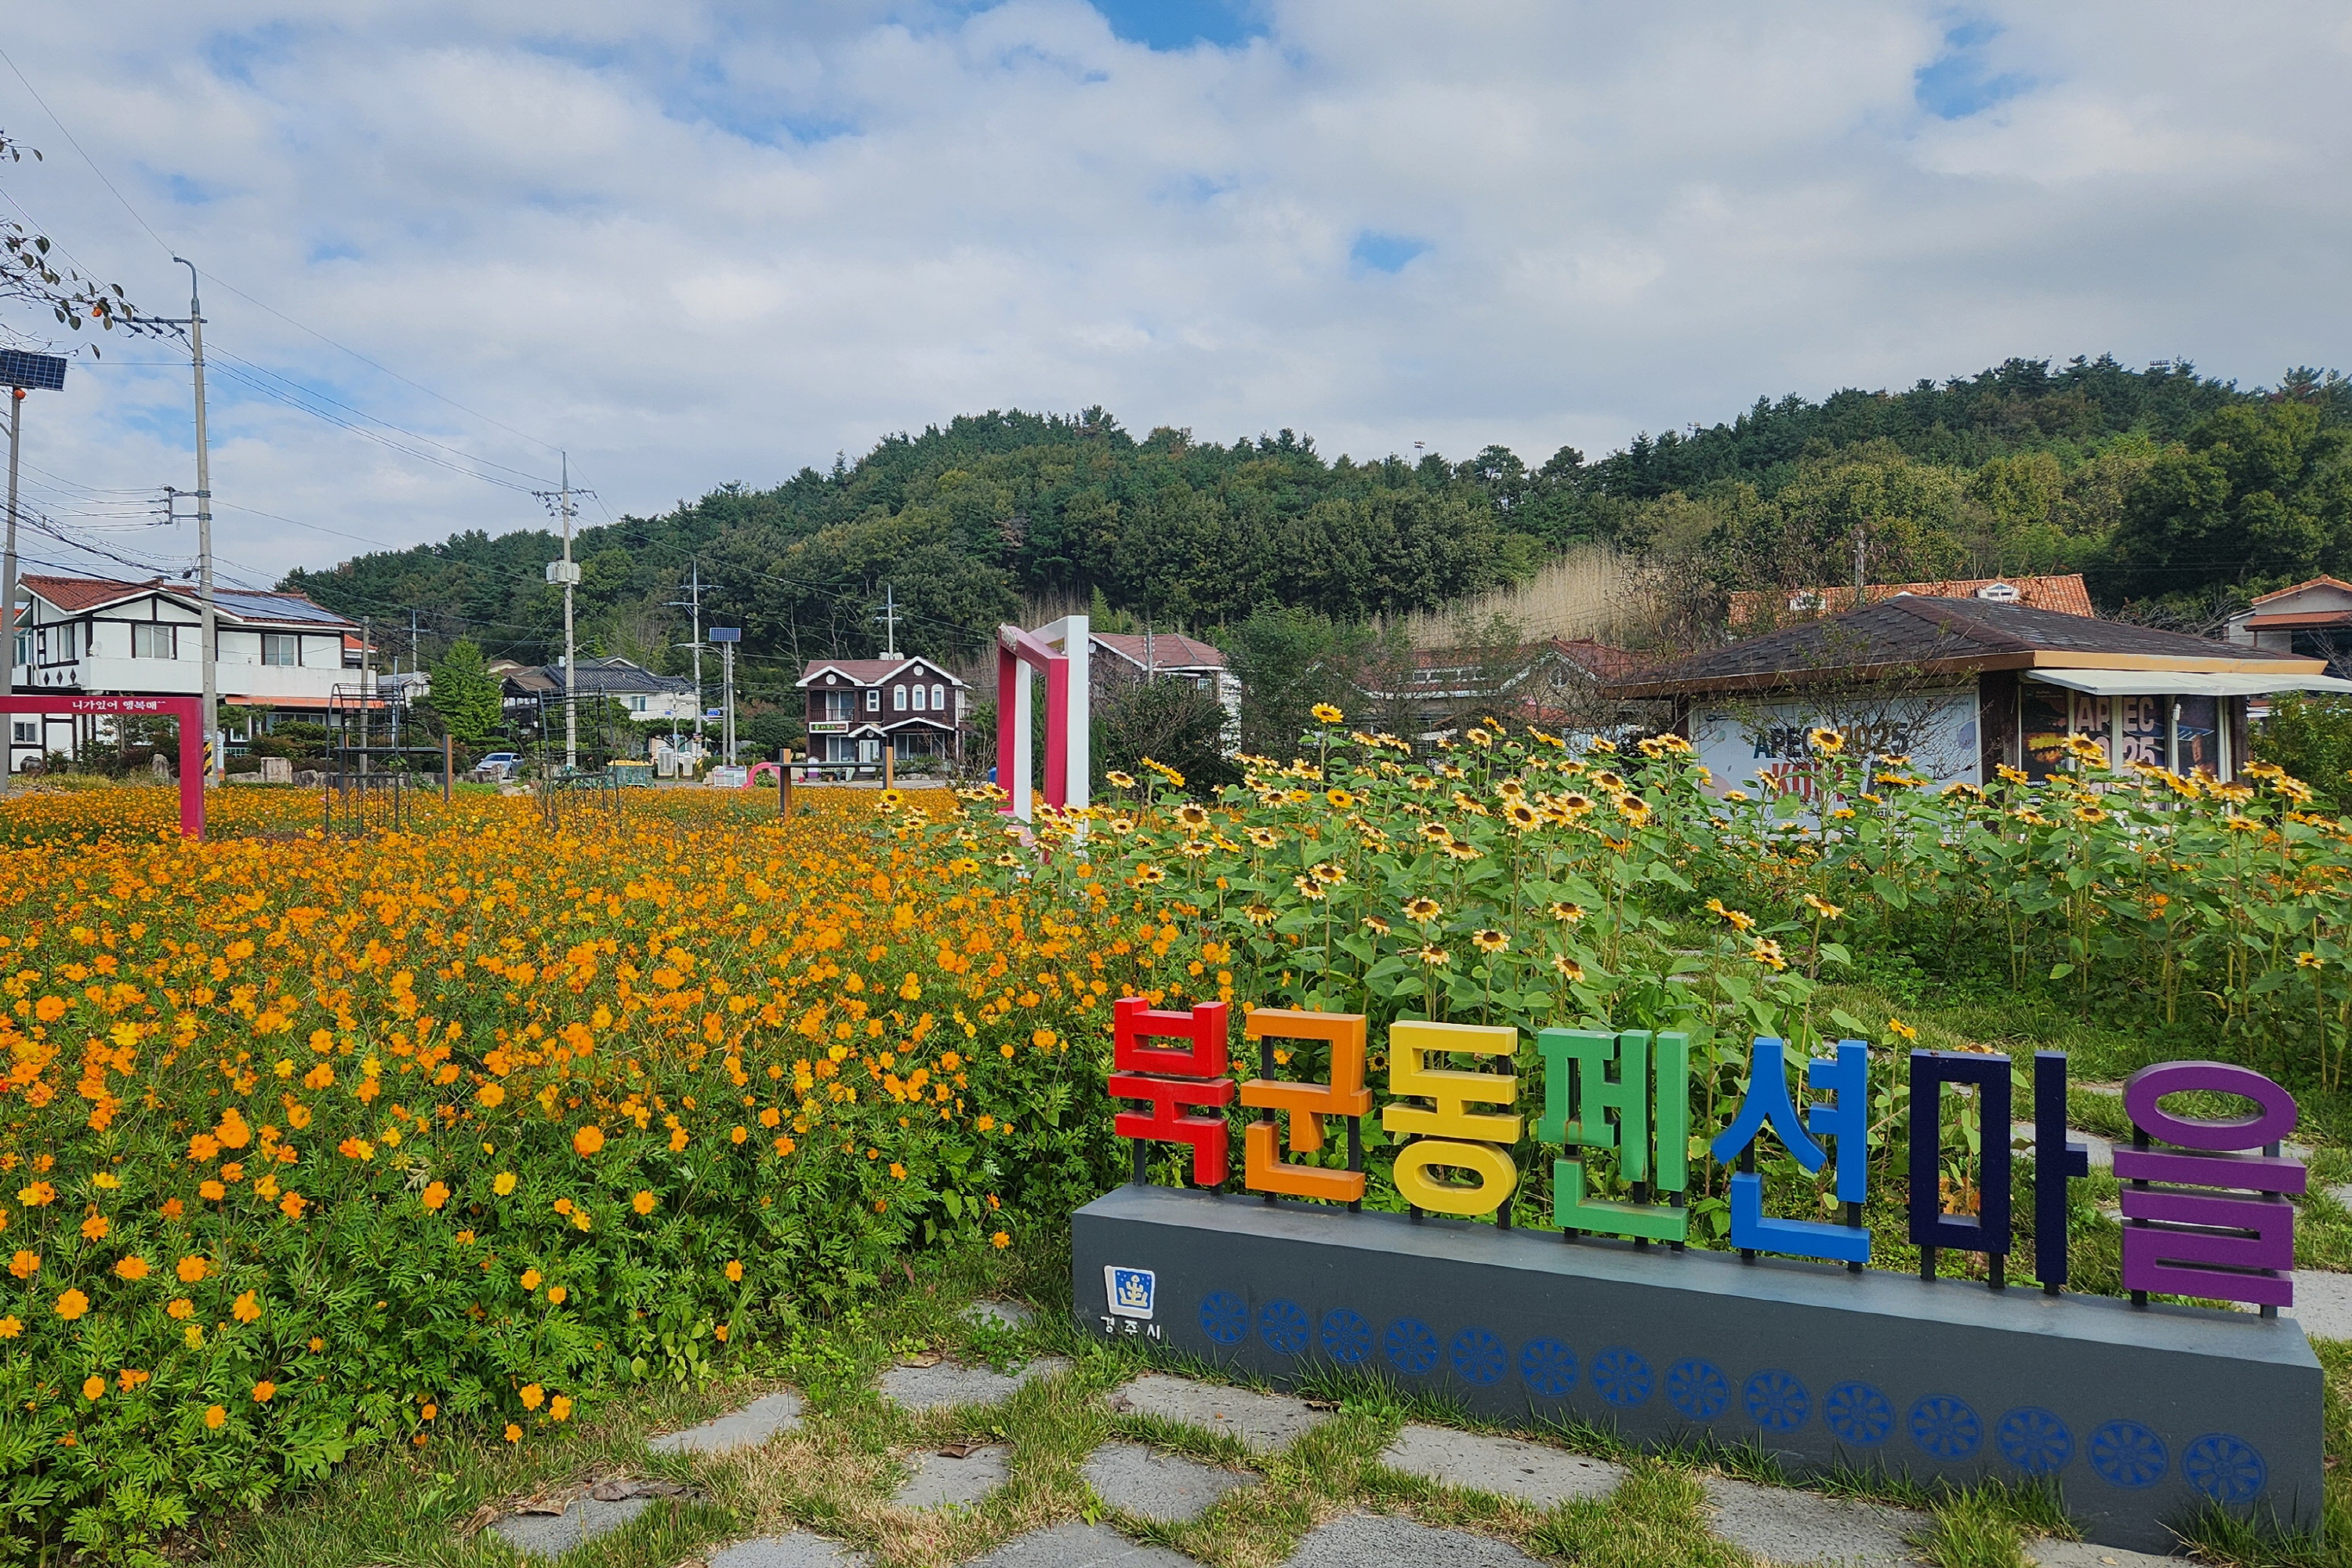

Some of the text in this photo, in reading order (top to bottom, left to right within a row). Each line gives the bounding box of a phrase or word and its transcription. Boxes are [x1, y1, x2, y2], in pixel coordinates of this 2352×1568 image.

[72, 700, 118, 710] 니가있어
[2074, 696, 2154, 732] APEC
[1100, 1316, 1160, 1340] 경주시
